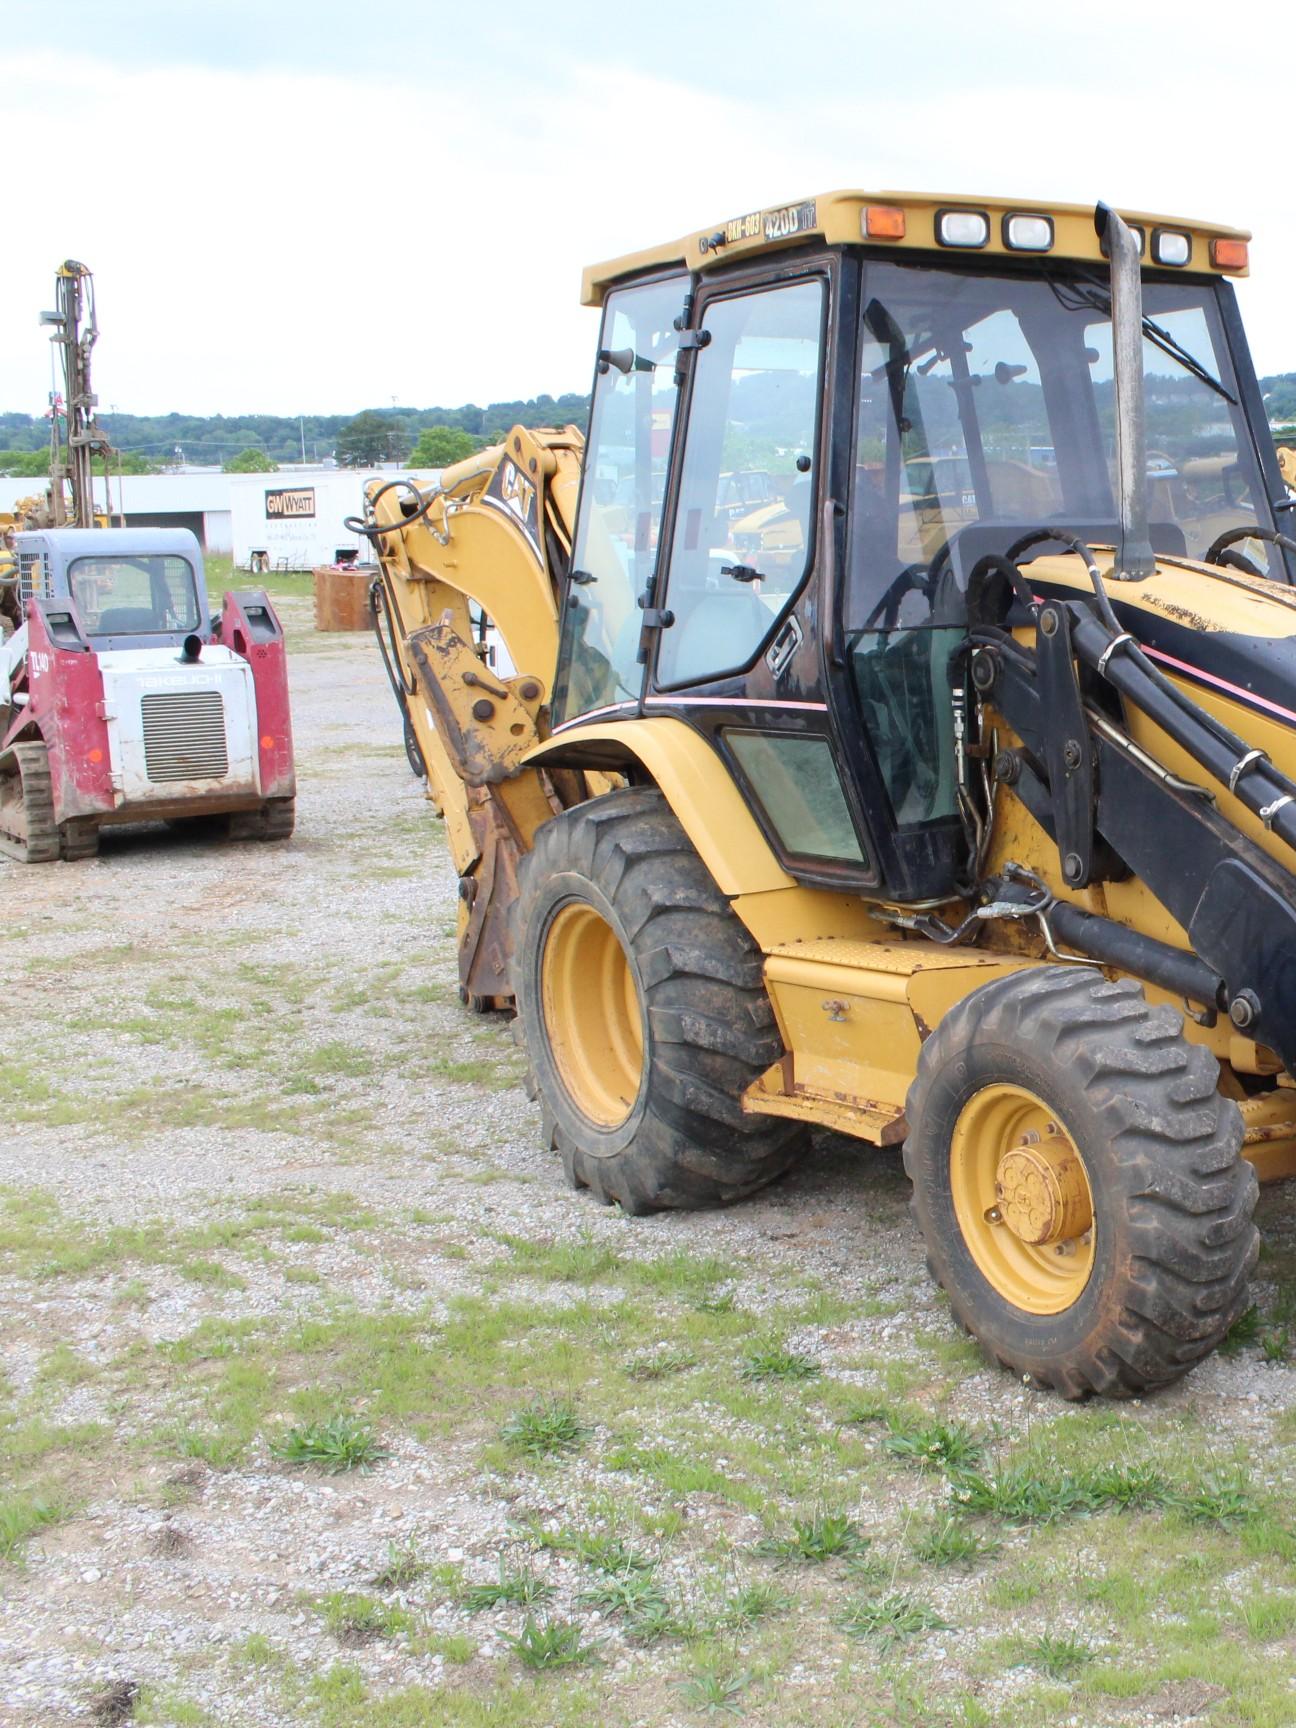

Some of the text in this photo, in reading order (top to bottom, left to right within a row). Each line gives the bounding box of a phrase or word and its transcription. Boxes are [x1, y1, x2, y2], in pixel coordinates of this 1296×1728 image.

[765, 208, 799, 238] 420D
[284, 495, 312, 512] WYATT
[502, 460, 536, 523] CAT
